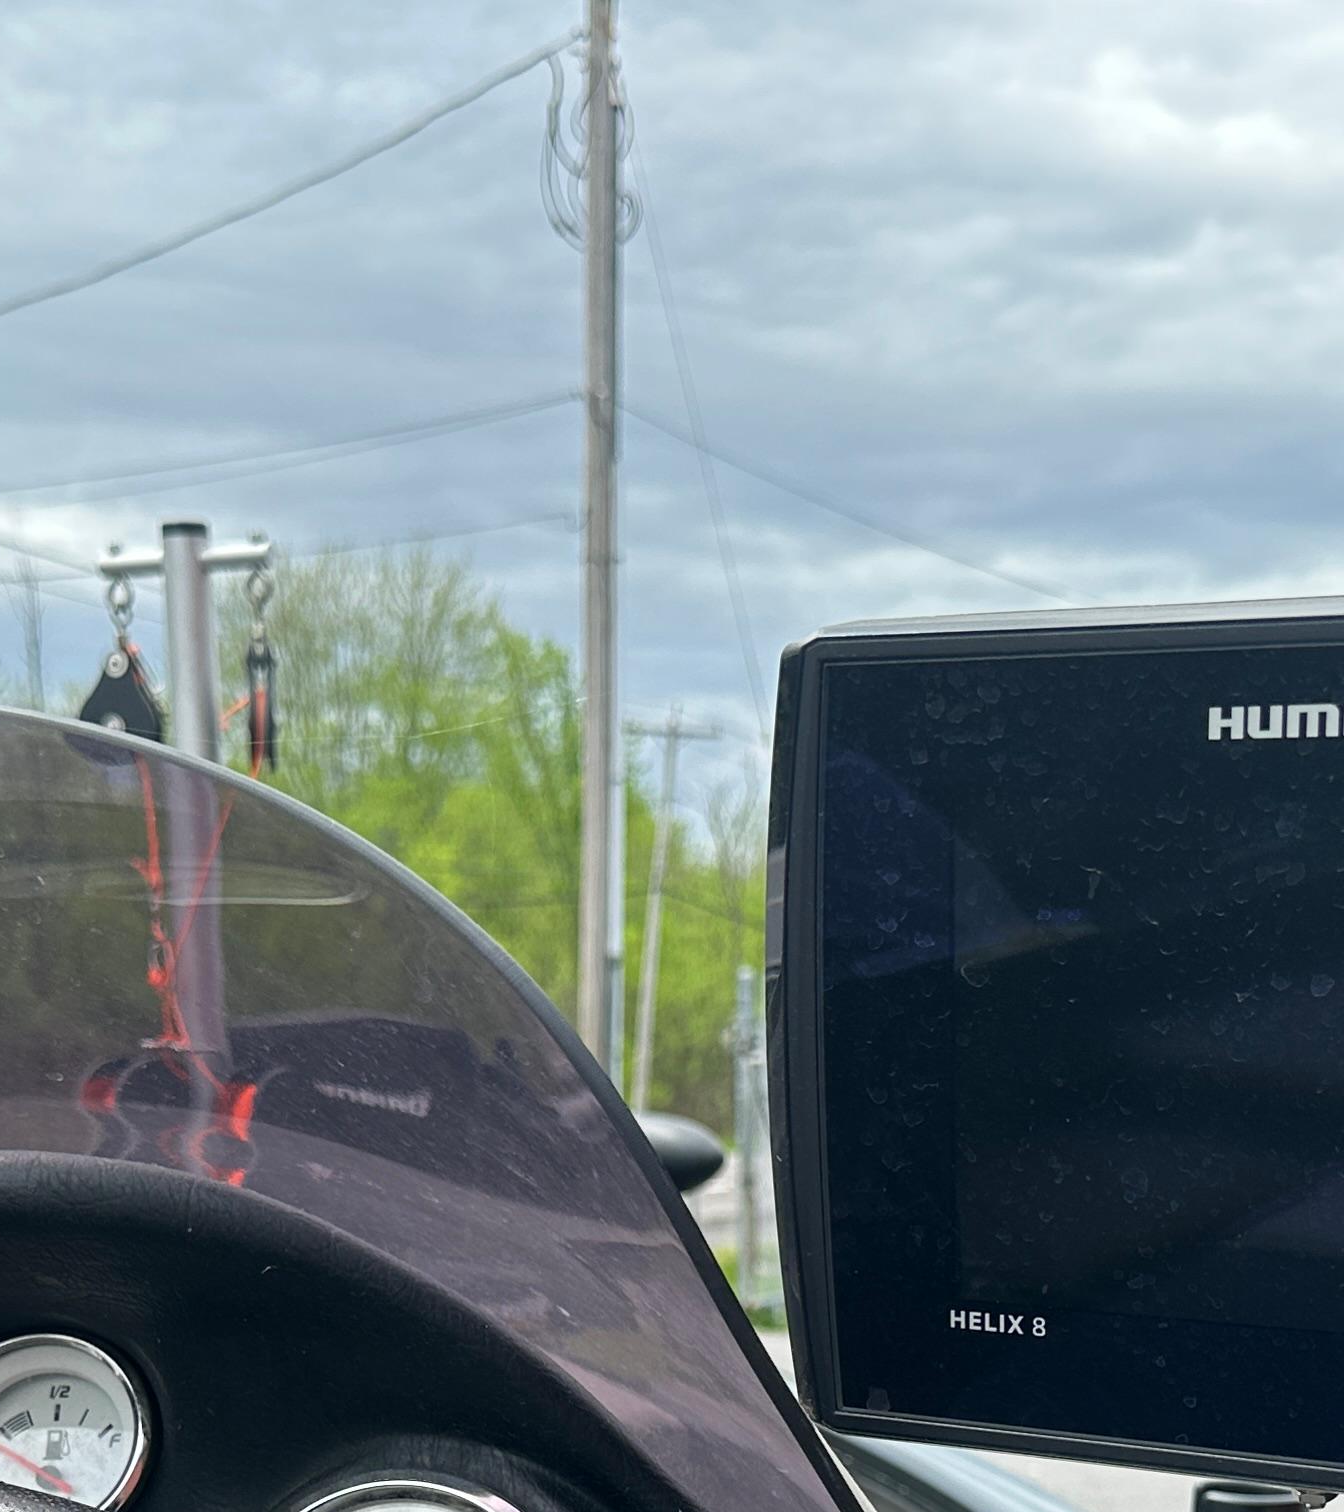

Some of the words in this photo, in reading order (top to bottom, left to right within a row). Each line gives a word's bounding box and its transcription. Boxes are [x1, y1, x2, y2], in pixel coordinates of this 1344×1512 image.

[949, 1309, 1025, 1336] HELIX
[1032, 1316, 1047, 1338] 8
[49, 1385, 72, 1400] 1/2
[109, 1433, 122, 1449] F
